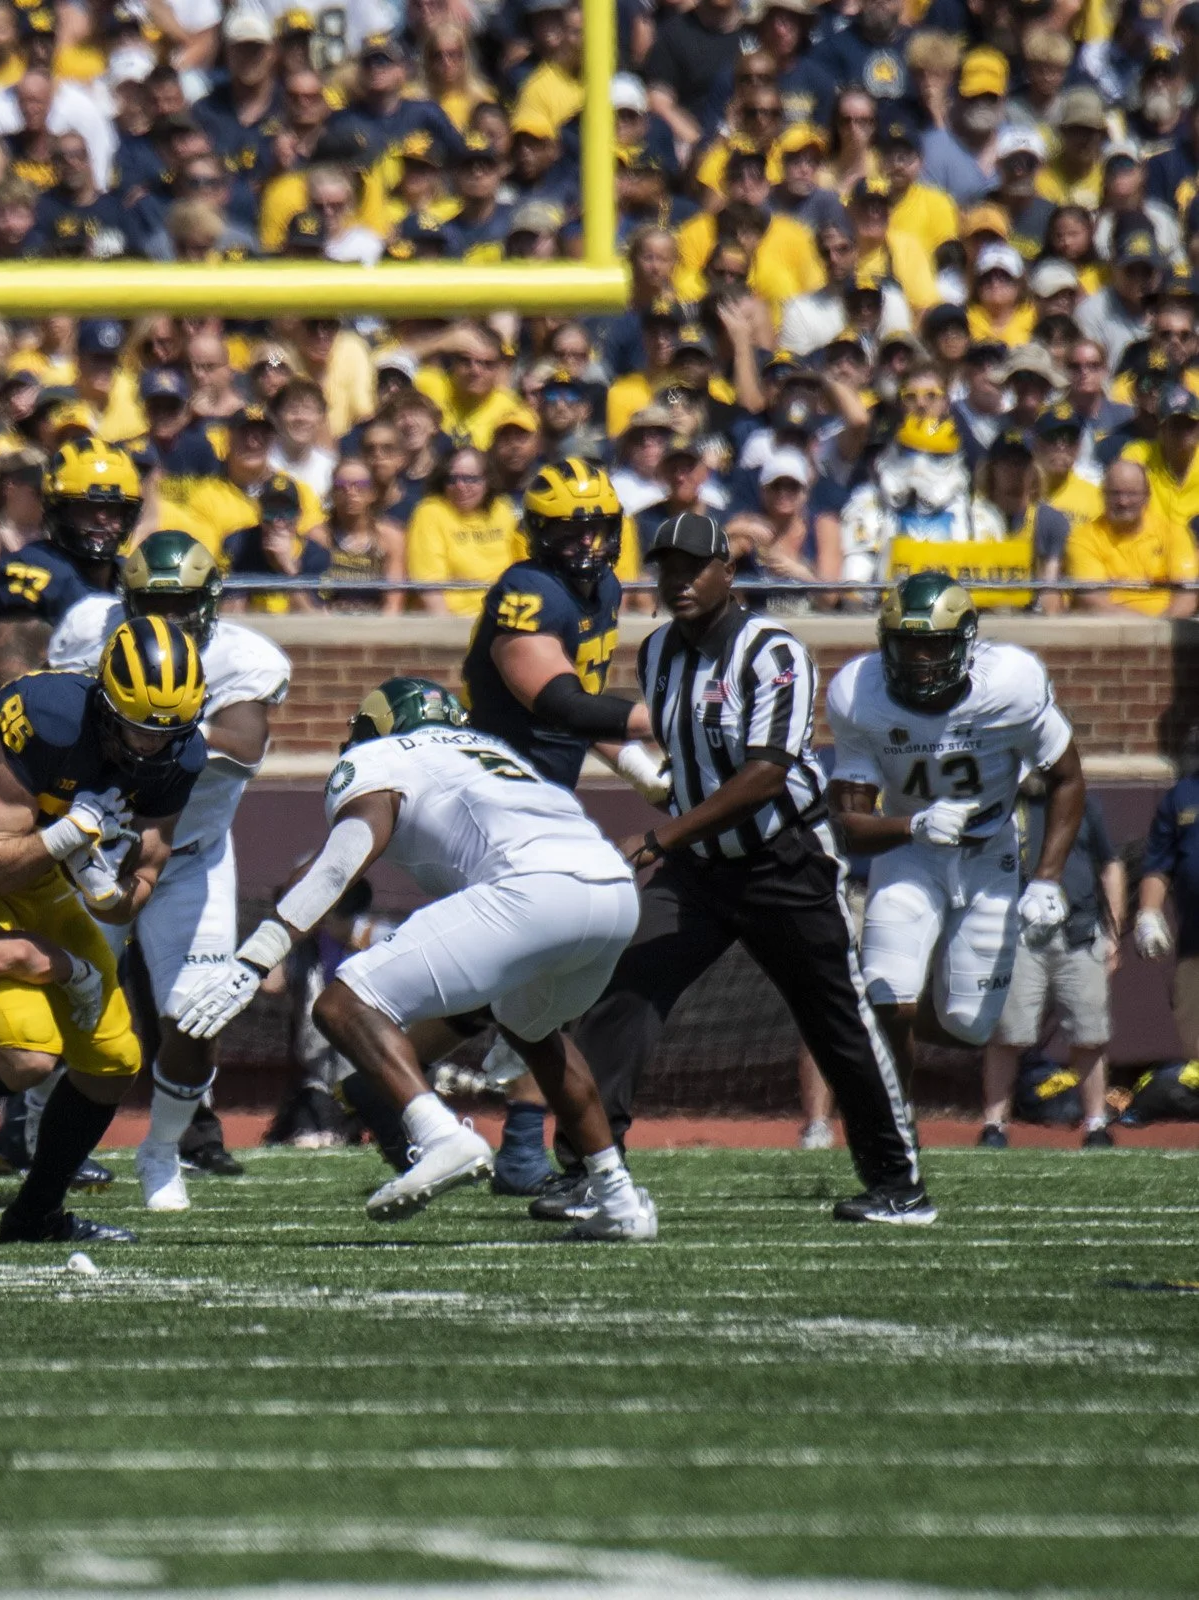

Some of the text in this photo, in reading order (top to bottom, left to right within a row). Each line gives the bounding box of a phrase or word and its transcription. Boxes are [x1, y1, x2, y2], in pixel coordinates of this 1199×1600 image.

[397, 737, 423, 750] D.
[706, 727, 722, 748] U
[883, 740, 983, 755] COLORADO STATE
[183, 953, 228, 965] RAM
